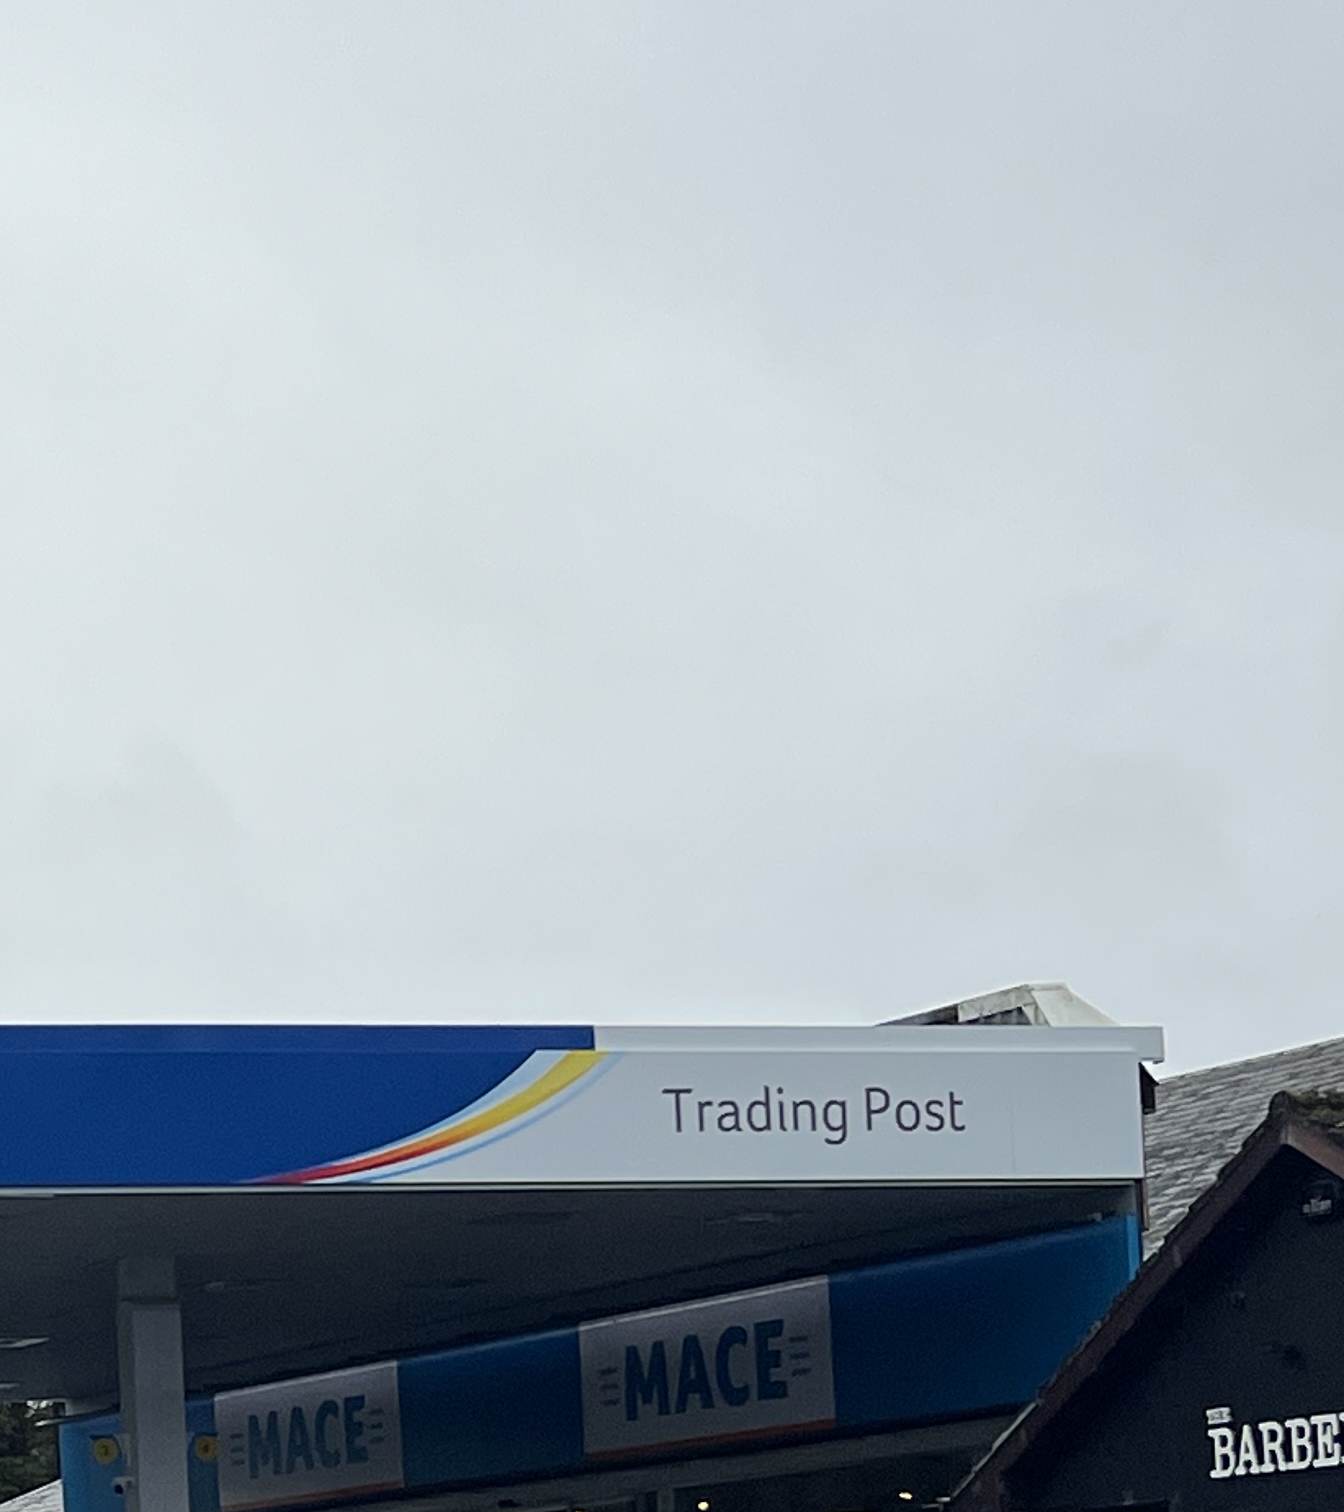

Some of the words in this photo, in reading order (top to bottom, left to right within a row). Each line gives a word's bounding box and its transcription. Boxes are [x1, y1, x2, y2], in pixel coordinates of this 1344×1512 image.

[662, 1085, 847, 1145] Trading
[864, 1086, 966, 1132] Post
[624, 1319, 789, 1421] MACE
[248, 1394, 369, 1479] MACE
[1207, 1412, 1344, 1479] BARBE
